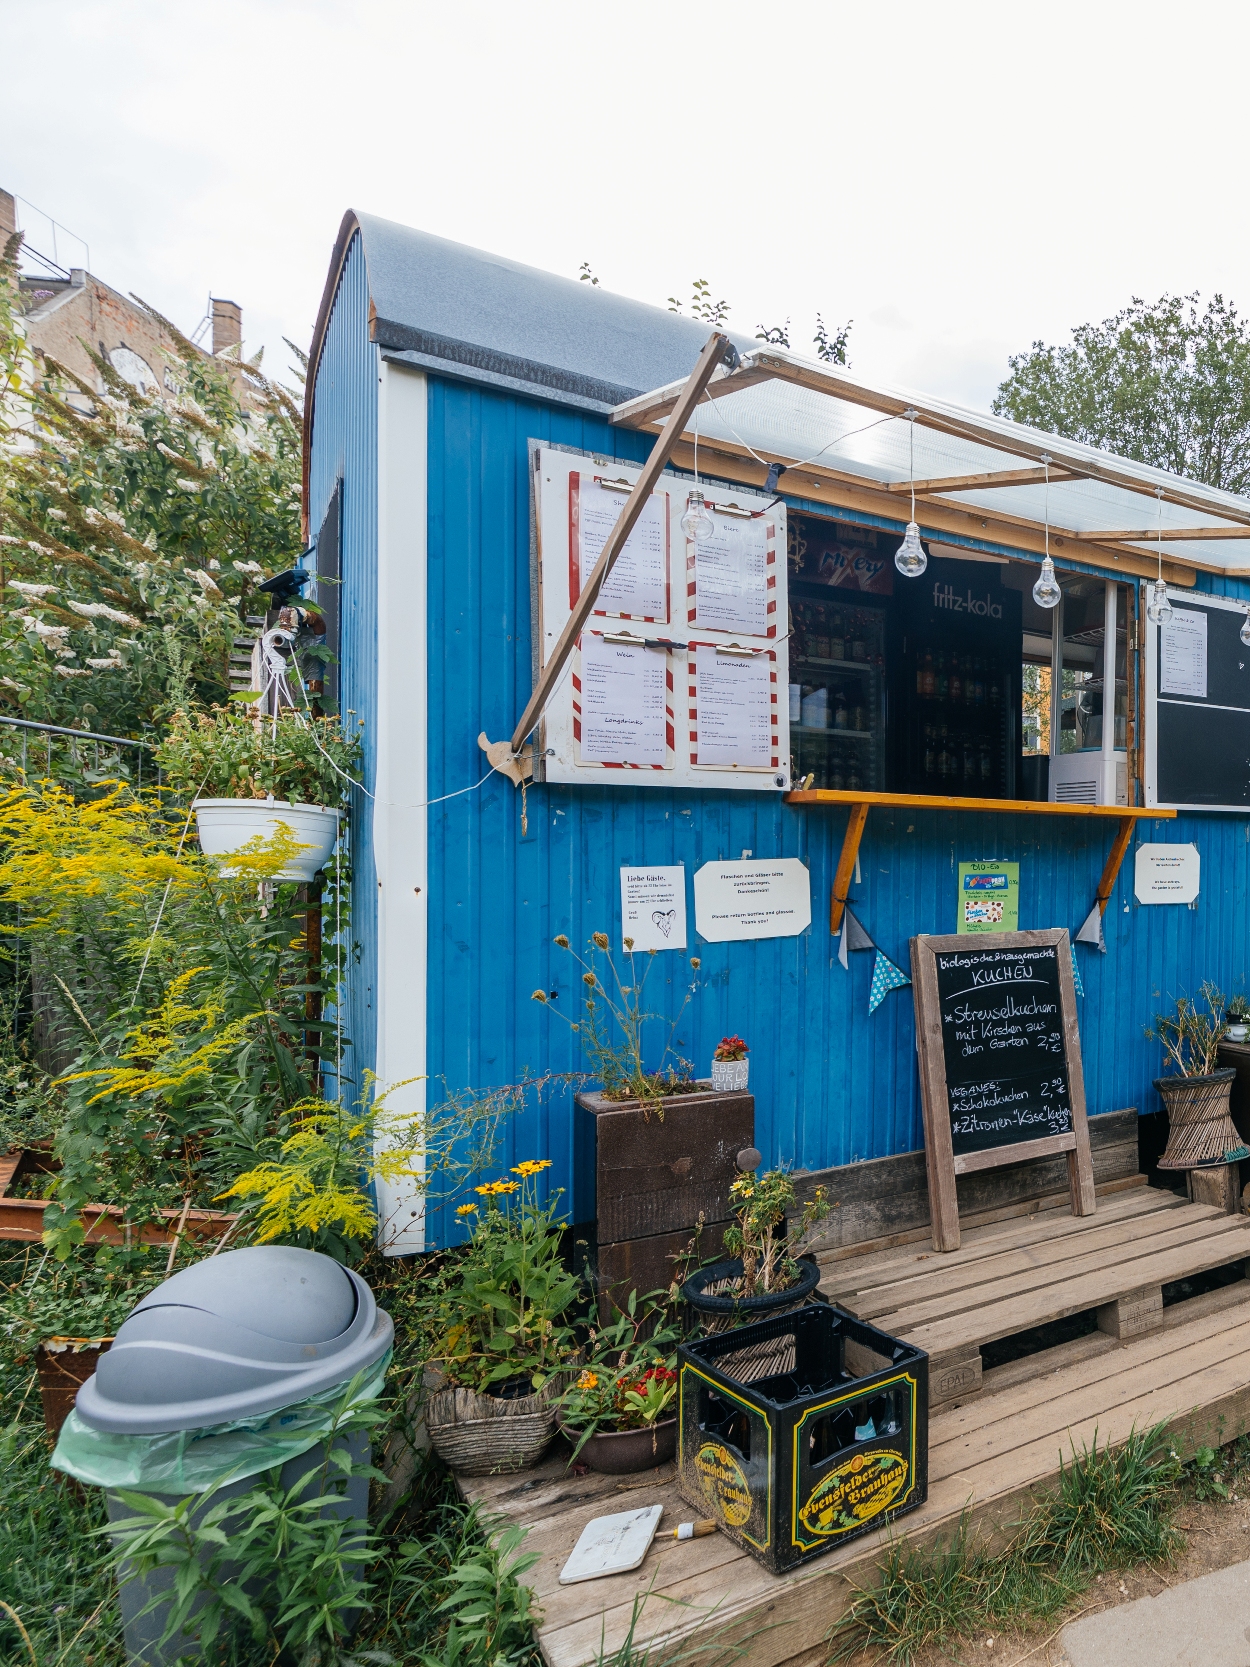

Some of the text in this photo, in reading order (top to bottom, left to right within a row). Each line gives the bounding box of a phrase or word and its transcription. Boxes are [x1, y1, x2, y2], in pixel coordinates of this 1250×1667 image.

[819, 549, 885, 582] Mixery
[933, 582, 1002, 618] fritz-kola
[716, 660, 752, 668] Limonaden
[940, 953, 993, 970] biologische
[972, 966, 1033, 985] KUCHEN
[954, 996, 1056, 1023] Streuselkuchen
[956, 1021, 1046, 1040] mit Kirschen aus
[990, 1036, 1029, 1049] Garten
[712, 1073, 733, 1082] OUR
[960, 1088, 1028, 1111] Schokokuchen
[848, 1460, 909, 1504] Brauhaus
[799, 1468, 875, 1520] Ebensfelder
